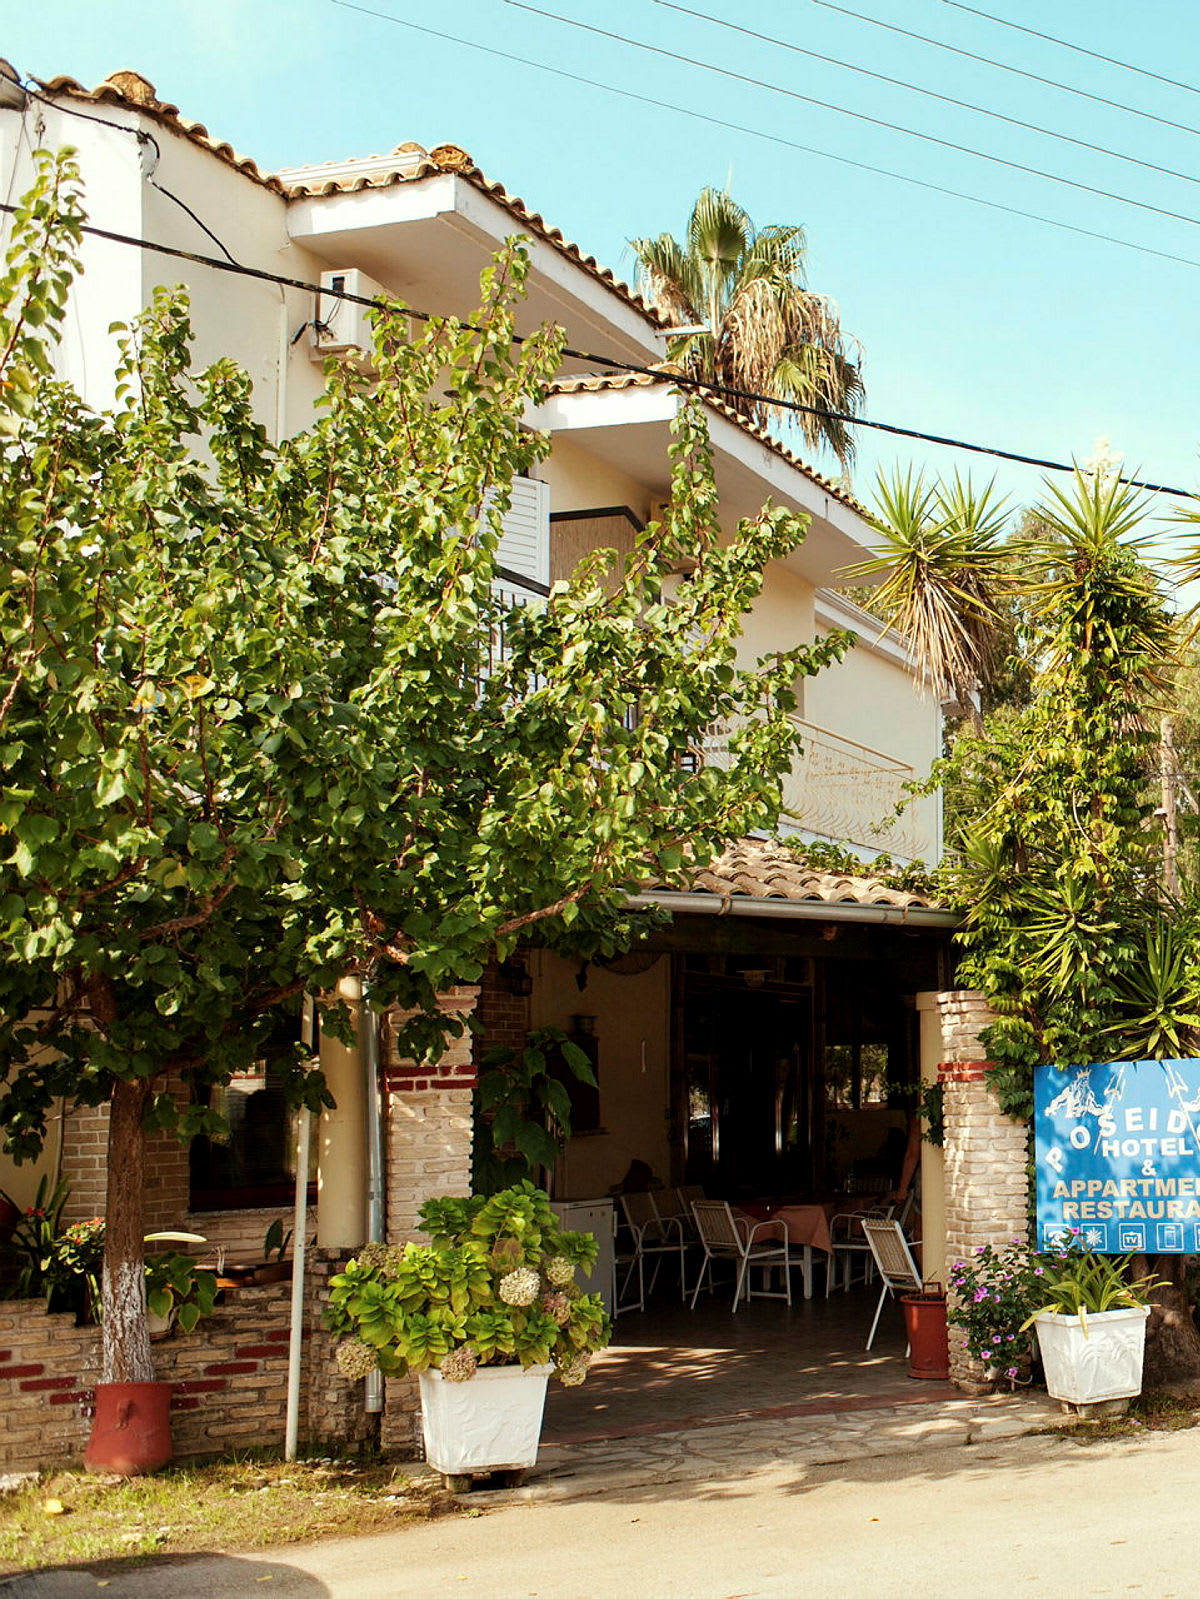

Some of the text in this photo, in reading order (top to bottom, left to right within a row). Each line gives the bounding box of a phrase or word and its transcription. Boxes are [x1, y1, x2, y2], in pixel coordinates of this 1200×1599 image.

[1102, 1138, 1194, 1158] HOTEL
[1141, 1159, 1157, 1177] &
[1125, 1236, 1138, 1244] TV
